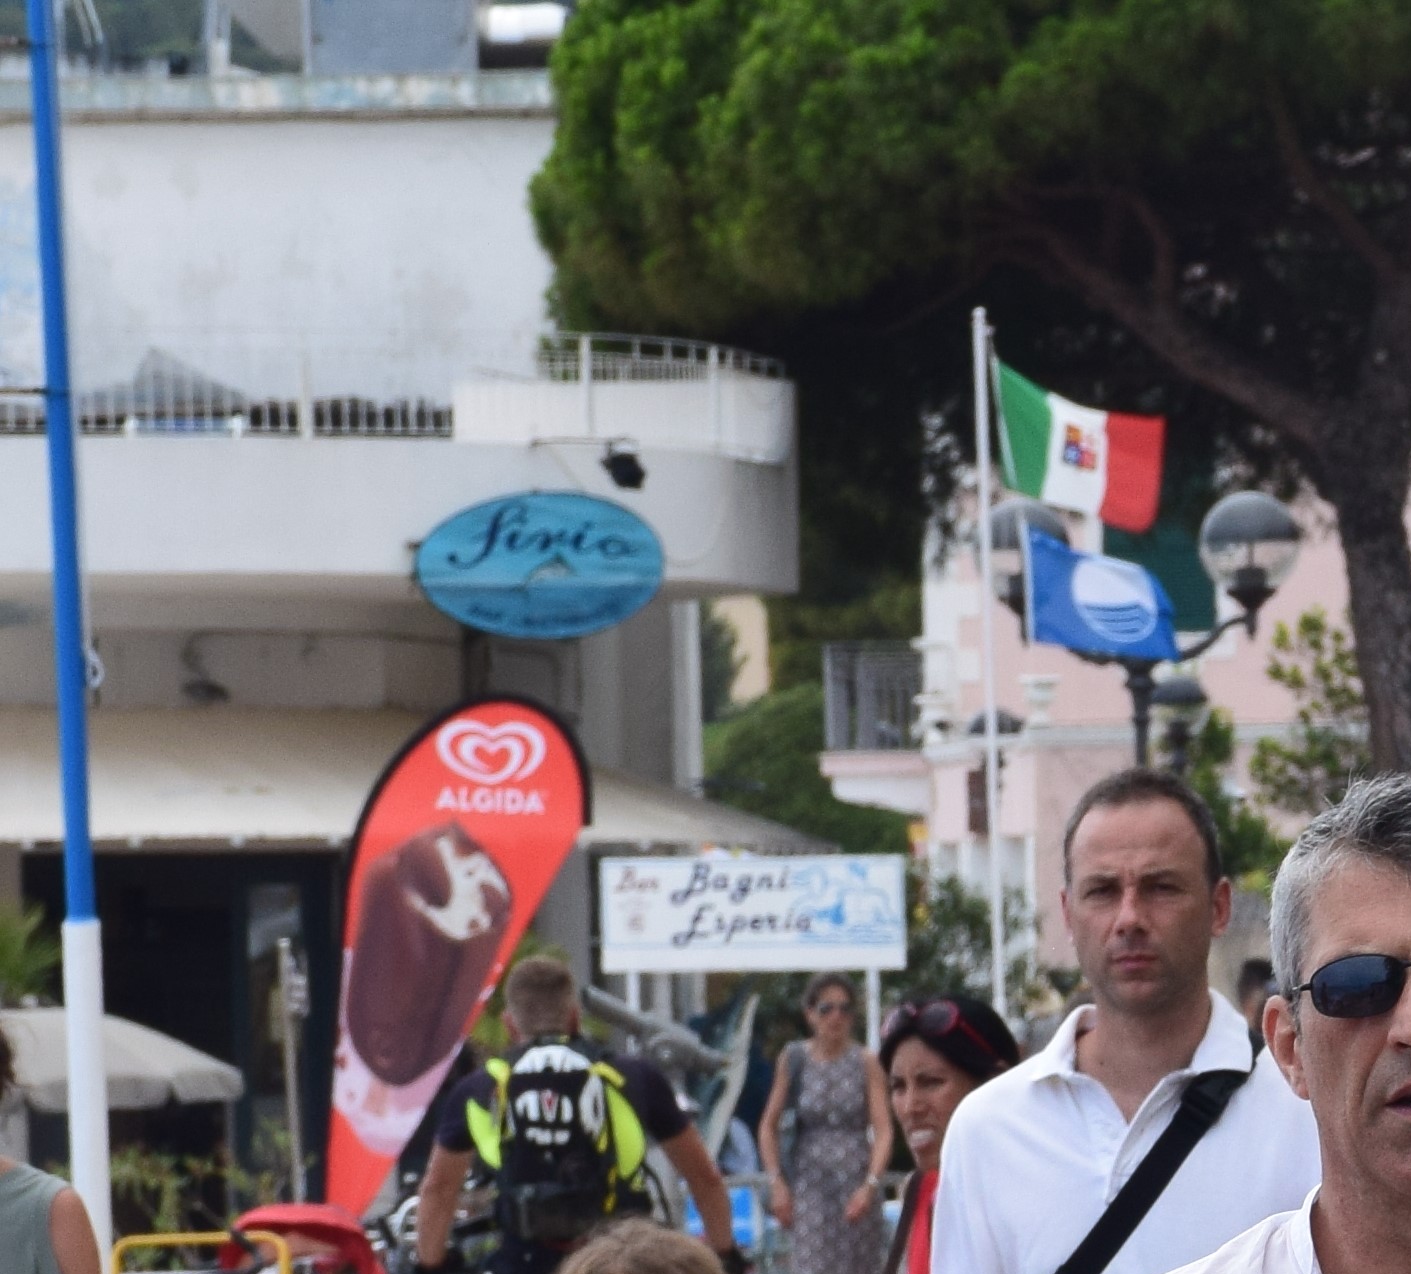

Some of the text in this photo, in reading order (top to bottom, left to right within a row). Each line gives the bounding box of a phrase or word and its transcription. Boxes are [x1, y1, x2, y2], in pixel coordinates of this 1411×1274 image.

[447, 502, 640, 570] Sirio
[433, 784, 547, 816] ALGIDA
[668, 861, 793, 906] Bagni
[671, 902, 813, 947] Esperia
